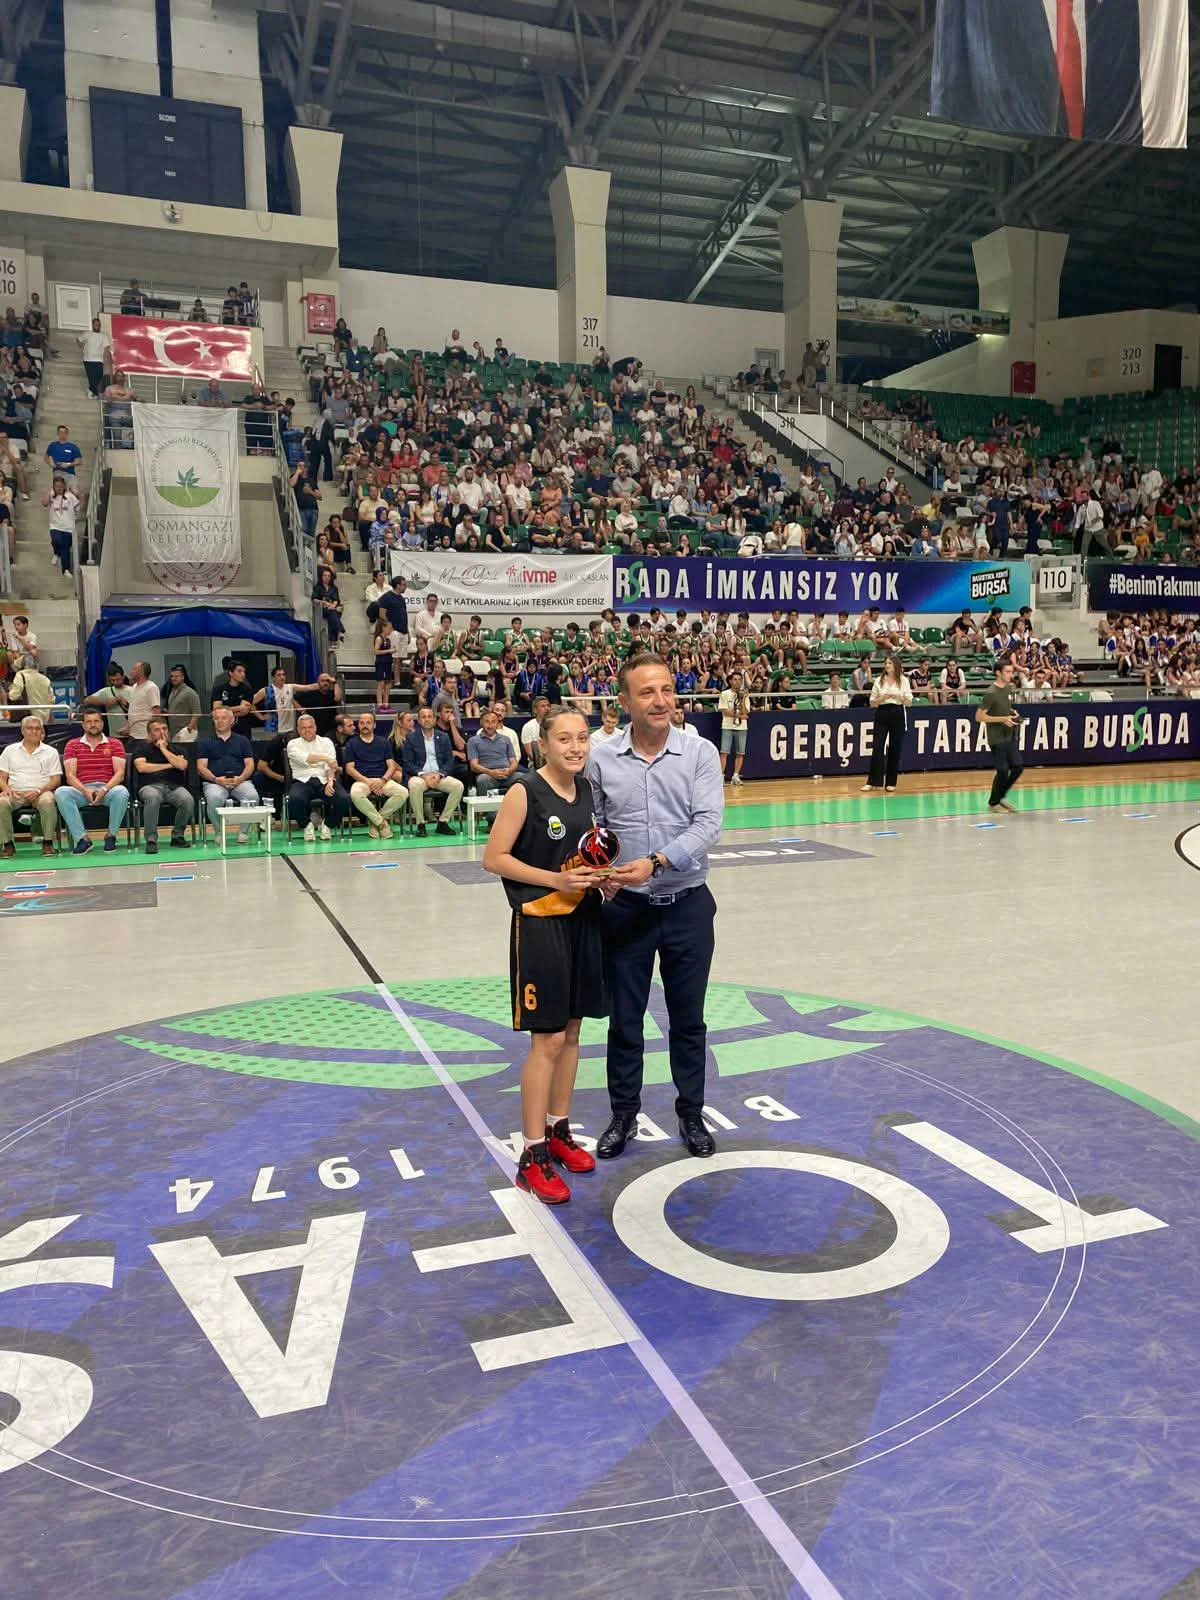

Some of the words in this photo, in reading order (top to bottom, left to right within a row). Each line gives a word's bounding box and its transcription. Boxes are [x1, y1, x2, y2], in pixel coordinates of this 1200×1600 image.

[0, 259, 16, 275] 16
[0, 279, 16, 295] 10
[583, 317, 598, 331] 317
[583, 334, 599, 348] 211
[1121, 348, 1142, 360] 320
[1121, 362, 1141, 376] 213
[523, 566, 557, 583] ivme
[705, 563, 837, 600] İMKANSIZ
[851, 572, 899, 601] YOK
[1043, 570, 1067, 589] 110
[972, 579, 1007, 598] BURSA
[404, 597, 428, 606] DEST
[440, 597, 453, 606] VE
[454, 597, 512, 607] KATKILARINIZ
[532, 597, 574, 607] TEŞEKKÜR
[576, 597, 605, 606] EDERİZ
[769, 719, 889, 768] GERÇE
[914, 716, 1069, 754] TARATAR
[1084, 706, 1190, 752] BURSADA
[523, 983, 537, 1011] 6
[168, 1148, 425, 1214] 1974
